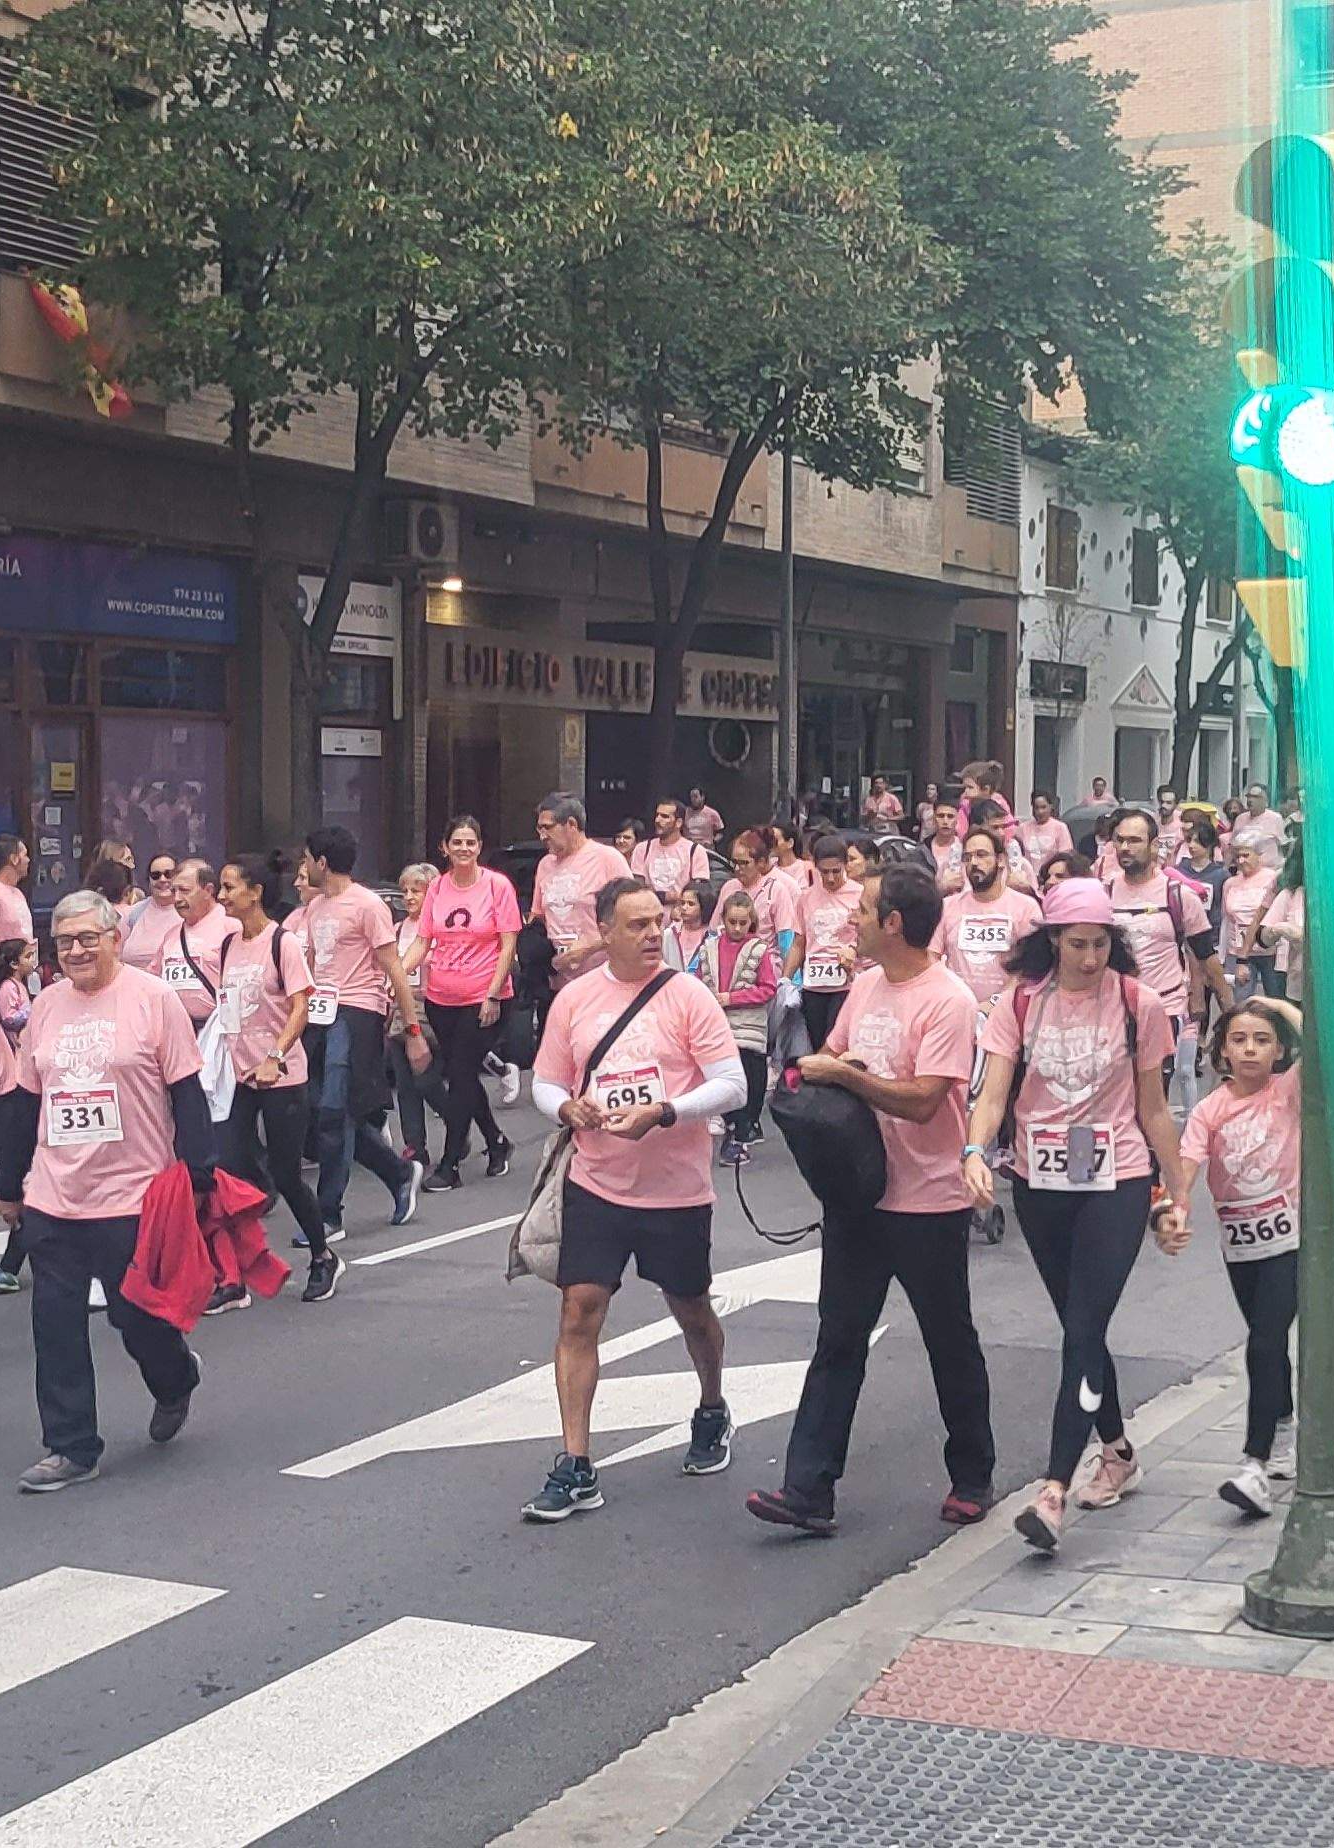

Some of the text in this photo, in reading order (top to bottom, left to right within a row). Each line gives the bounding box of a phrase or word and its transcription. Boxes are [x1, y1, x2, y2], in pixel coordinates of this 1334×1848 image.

[107, 599, 225, 621] WWW.COPISTERIACRM.COM
[351, 603, 389, 619] MINOLTA
[573, 655, 653, 701] VALLE
[964, 927, 1006, 943] 3455
[809, 964, 843, 979] 3741
[607, 1084, 653, 1110] 695
[61, 1106, 105, 1130] 331
[1037, 1149, 1107, 1173] 257
[1226, 1212, 1292, 1247] 2566
